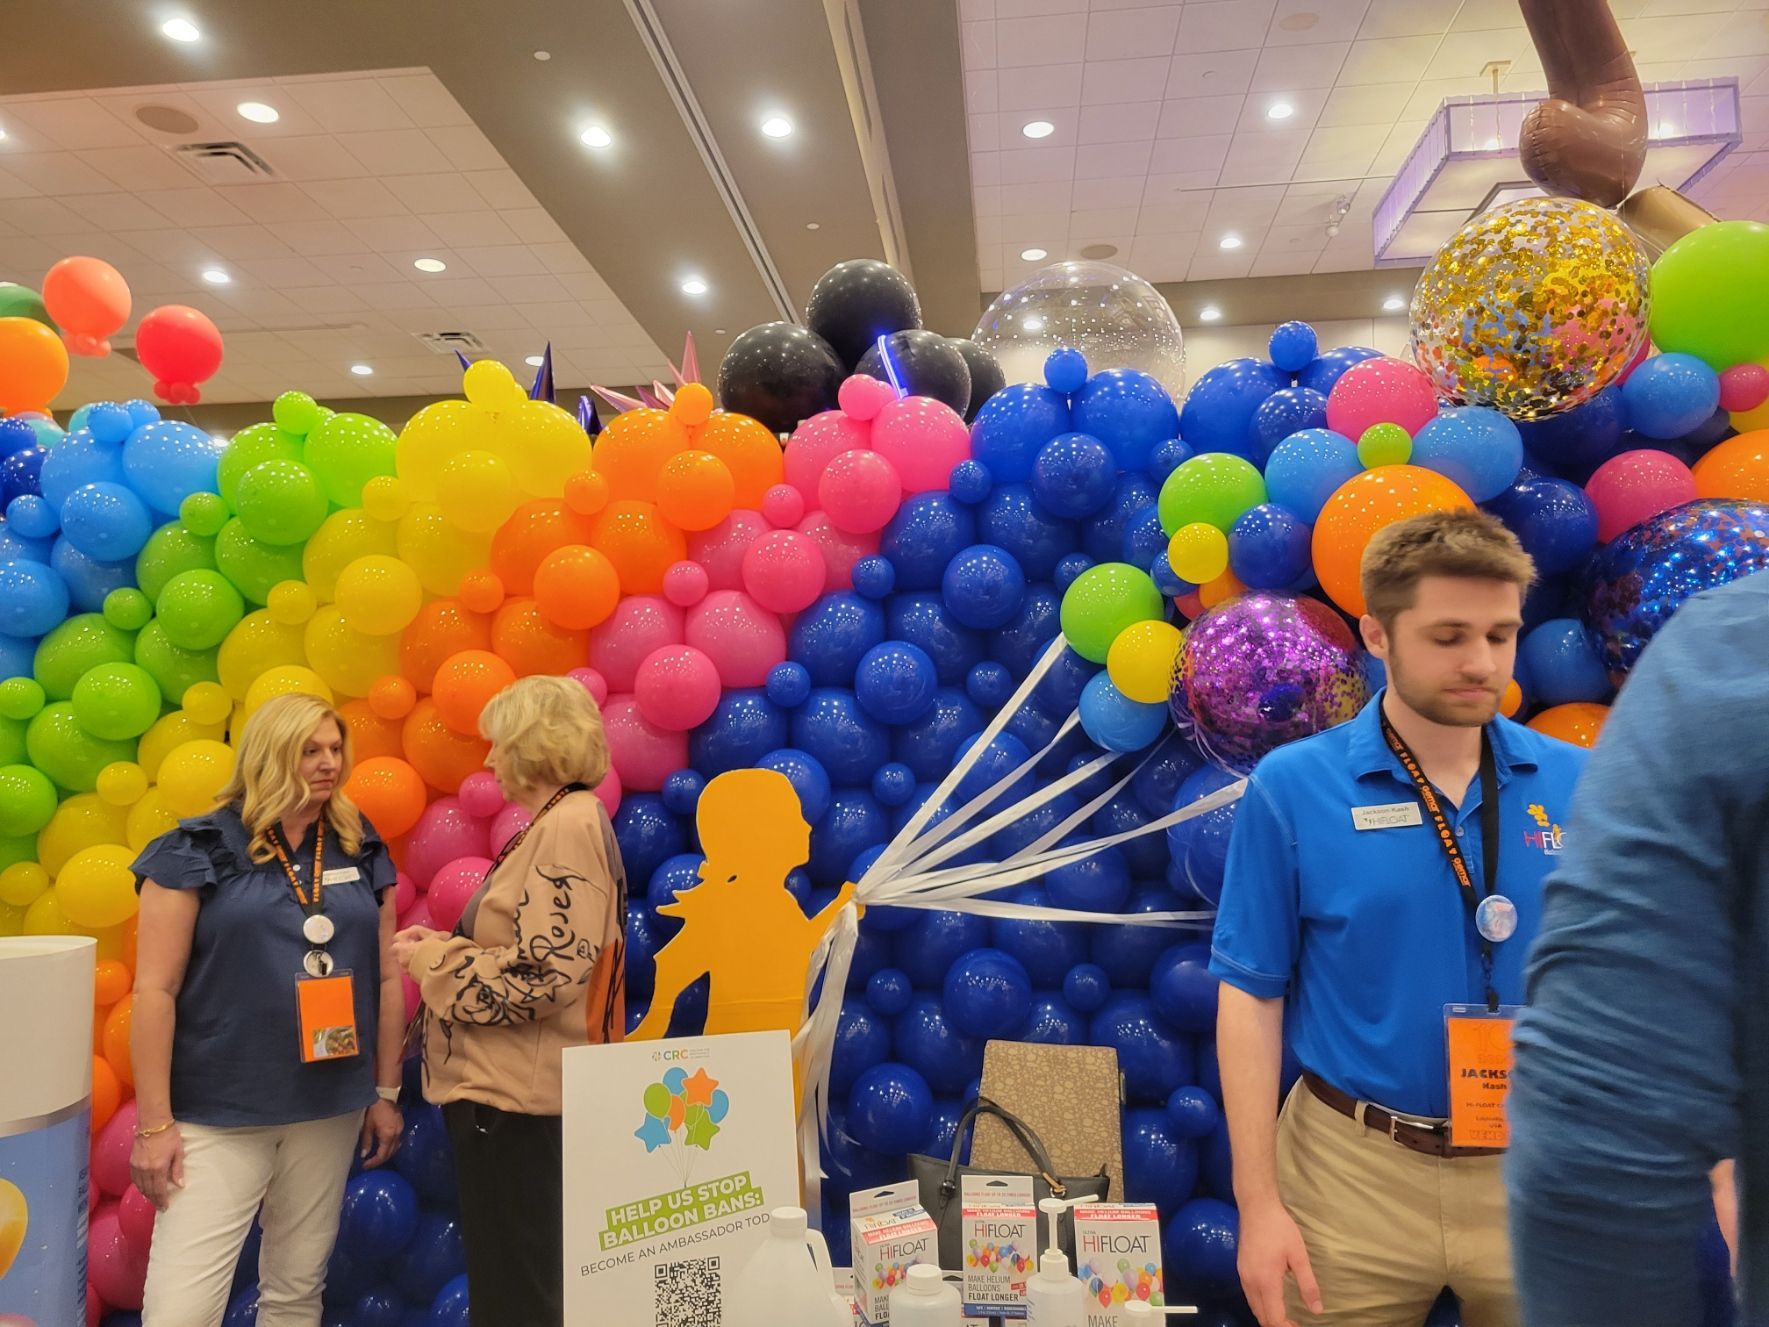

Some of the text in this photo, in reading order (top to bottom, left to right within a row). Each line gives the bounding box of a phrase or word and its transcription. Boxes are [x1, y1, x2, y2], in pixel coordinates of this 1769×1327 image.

[663, 1049, 689, 1061] CRC
[611, 1175, 747, 1226] HELP US STOP
[603, 1191, 760, 1249] BALLOON BANS:
[975, 1223, 1027, 1239] HIFLOAT
[580, 1212, 771, 1277] BECOME AN AMBASSADOR TOD
[880, 1238, 929, 1261] HIFLOAT
[1082, 1235, 1152, 1254] HIFLOAT
[968, 1275, 1011, 1284] MAKE HELIUM
[968, 1284, 1001, 1292] BALLOONS
[968, 1292, 1019, 1302] FLOAT LONGER
[874, 1304, 889, 1312] BALL
[1087, 1314, 1118, 1327] MAKE
